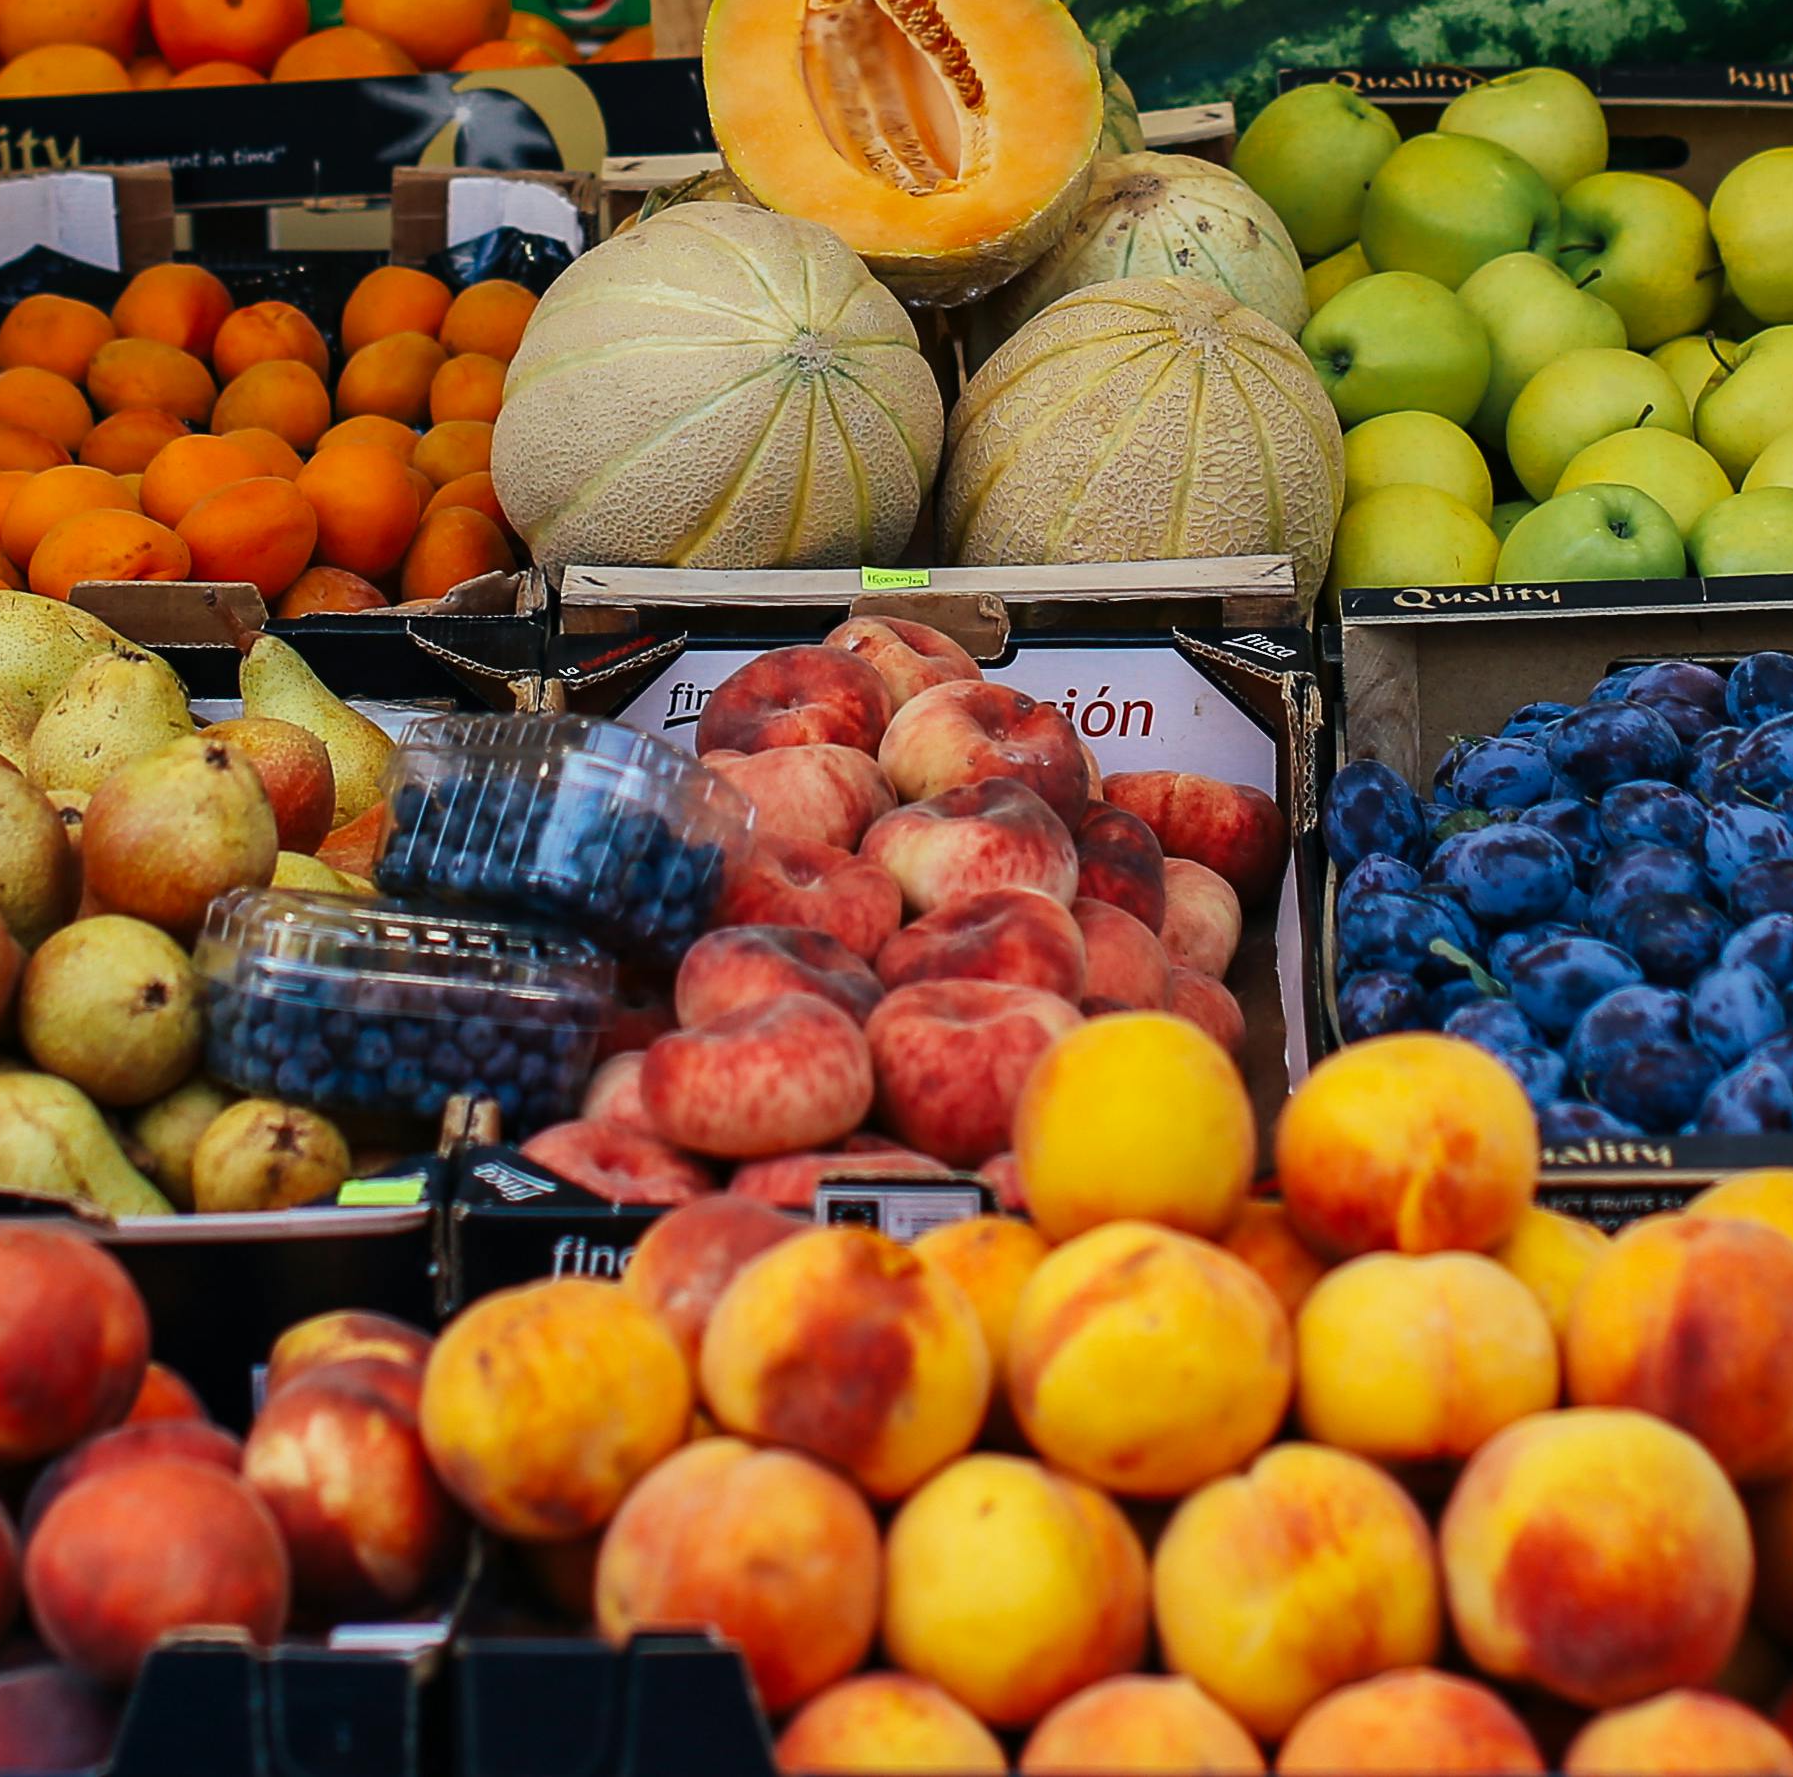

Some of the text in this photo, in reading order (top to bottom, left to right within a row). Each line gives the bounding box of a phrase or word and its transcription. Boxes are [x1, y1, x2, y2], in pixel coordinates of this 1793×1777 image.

[1329, 70, 1473, 93] Quality
[1393, 585, 1561, 610] Quality
[1232, 633, 1297, 659] finca
[666, 682, 713, 717] fin
[1040, 685, 1156, 737] ión
